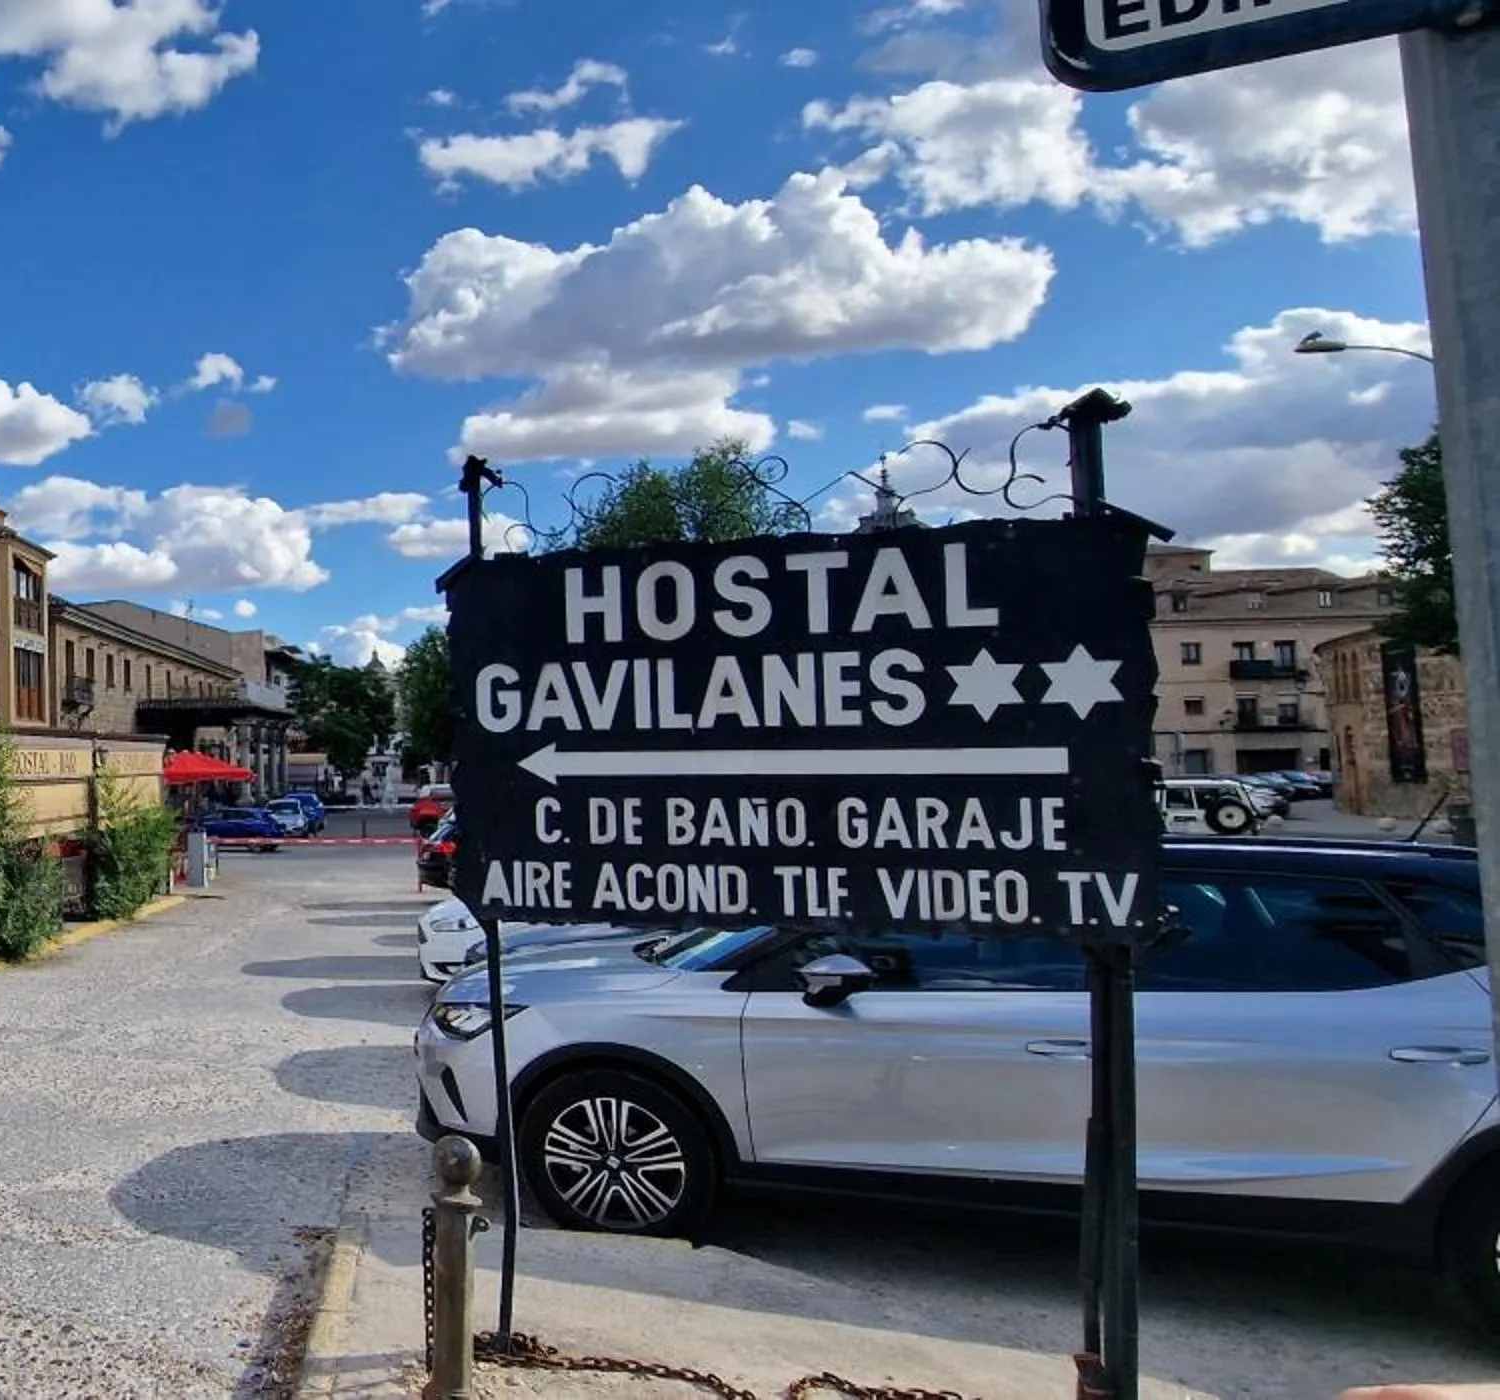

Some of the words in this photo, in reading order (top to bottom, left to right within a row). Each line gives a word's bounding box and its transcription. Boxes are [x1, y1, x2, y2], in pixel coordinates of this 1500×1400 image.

[562, 543, 1000, 645] HOSTAL
[474, 648, 925, 735] GAVILANES
[535, 797, 570, 844] C.
[589, 798, 643, 845] DE
[666, 797, 815, 847] BAÑO.
[837, 797, 1067, 850] GARAJE
[481, 860, 572, 909] AIRE
[592, 862, 757, 914] ACOND.
[876, 868, 1041, 924] VIDEO.
[1057, 871, 1144, 927] T.V.
